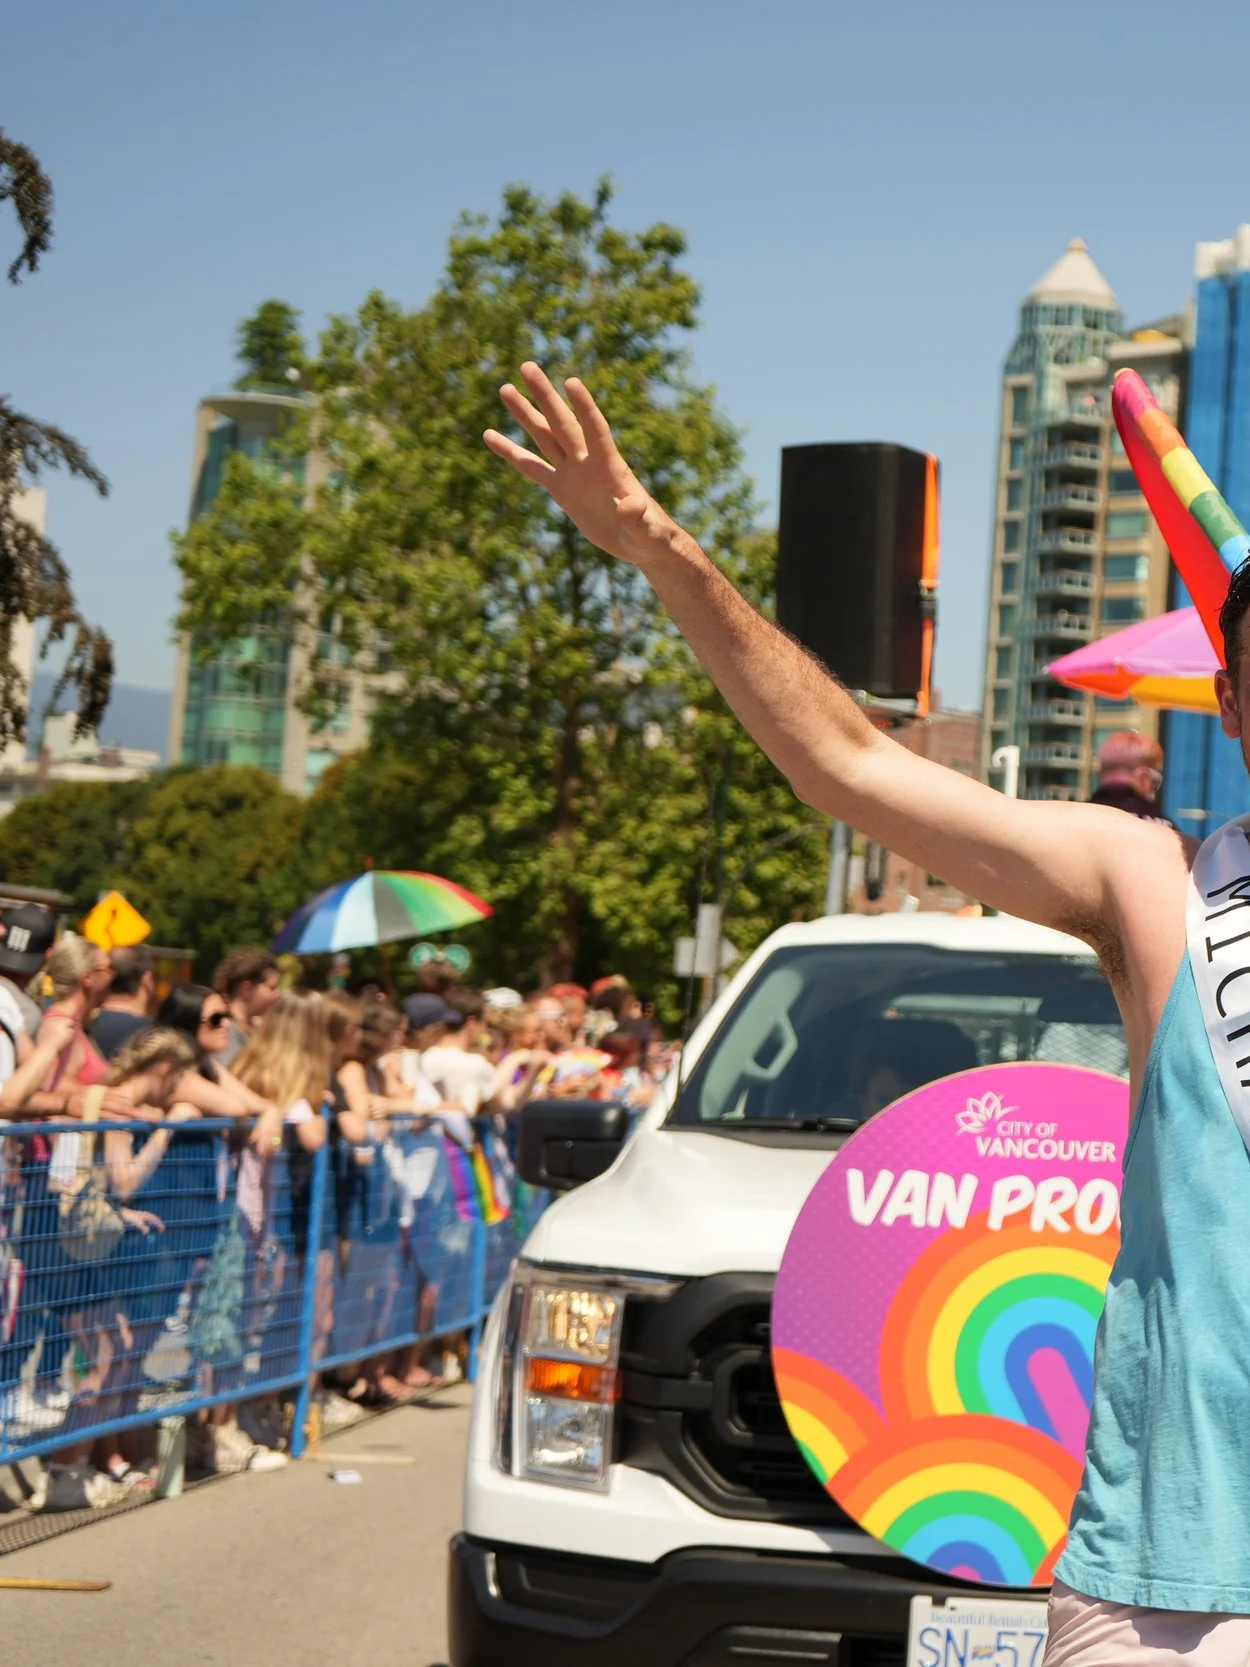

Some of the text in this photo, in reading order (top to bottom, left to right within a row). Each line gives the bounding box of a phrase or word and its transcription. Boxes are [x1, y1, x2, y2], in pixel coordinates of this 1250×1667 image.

[997, 1120, 1059, 1138] CITY OF
[975, 1136, 1117, 1163] VANCOUVER
[846, 1168, 1121, 1236] VAN PRO
[930, 1612, 986, 1626] Beautiful
[988, 1614, 1026, 1628] British
